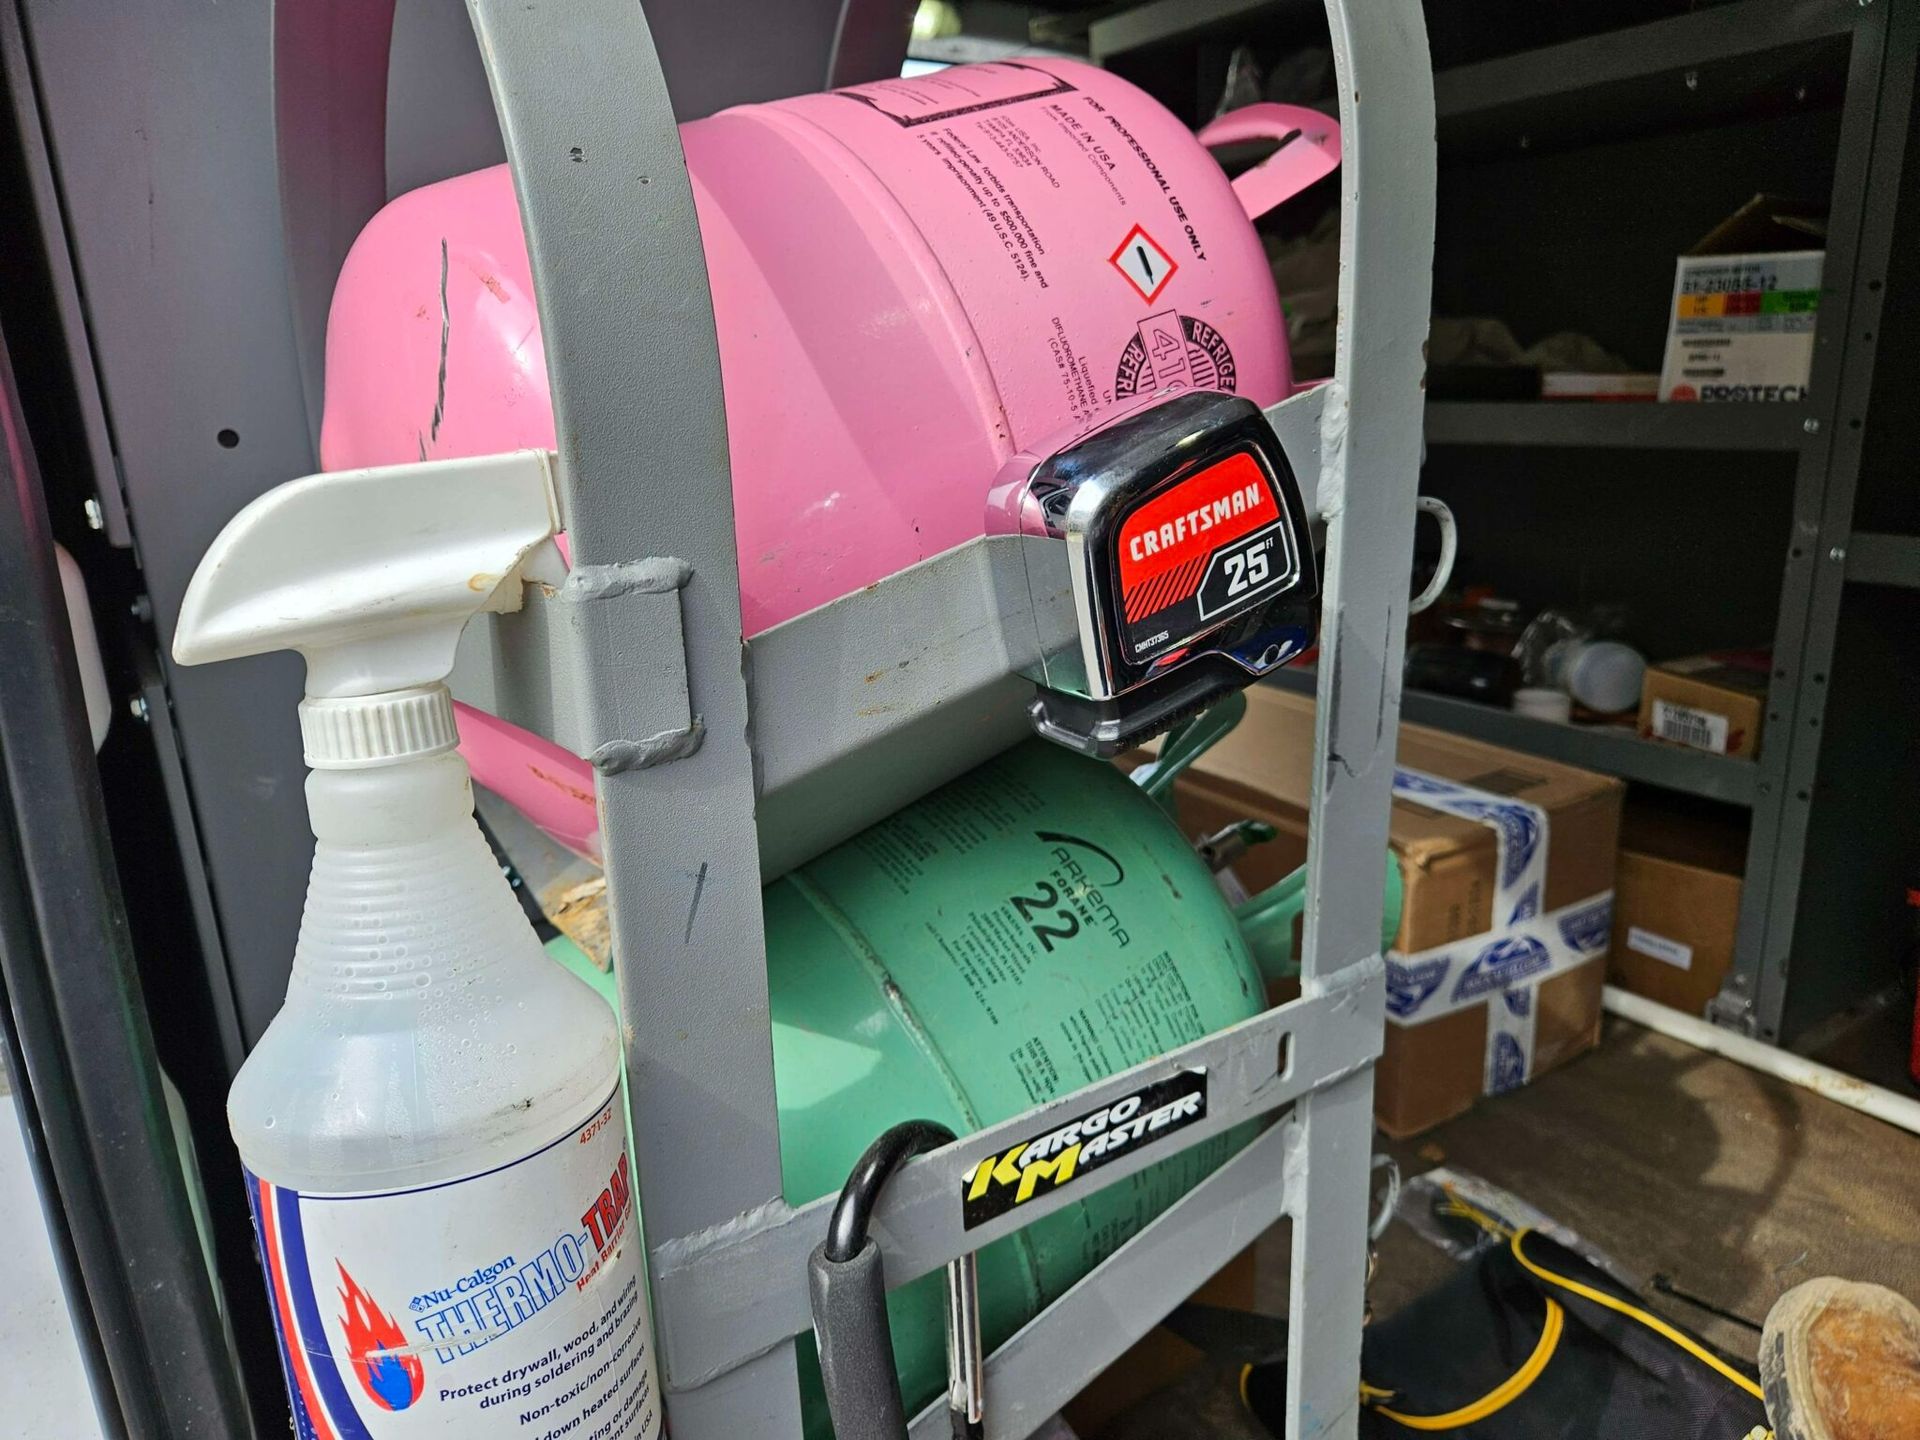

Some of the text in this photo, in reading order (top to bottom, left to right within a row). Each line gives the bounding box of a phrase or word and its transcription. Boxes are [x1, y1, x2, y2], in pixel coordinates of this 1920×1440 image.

[1050, 104, 1116, 171] MADE IN USA
[982, 166, 1006, 194] forbids
[1003, 194, 1045, 256] transportation
[1041, 166, 1060, 188] ROAD
[1083, 96, 1207, 262] FOR PROFESSIONAL USE ONLY
[1087, 153, 1127, 206] Components
[942, 158, 986, 208] imprisonment
[982, 208, 997, 223] (49
[993, 223, 1014, 252] U.S.C.
[1010, 253, 1030, 282] 5124).
[982, 186, 993, 199] up
[991, 198, 1000, 208] to
[1000, 210, 1028, 250] $500,000
[1024, 250, 1038, 269] fine
[1035, 269, 1049, 289] and
[1048, 337, 1065, 368] (CAS#
[1061, 373, 1079, 412] 75-10-5
[1051, 317, 1088, 410] DIFLUOROMETHANE
[1078, 356, 1098, 406] Liquefied
[1129, 482, 1260, 562] CRAFTSMAN
[1224, 536, 1274, 597] 25 FT
[1010, 881, 1079, 952] 22
[1050, 870, 1094, 926] FORANE
[580, 1107, 611, 1144] 4371-32
[968, 1096, 1142, 1201] KARGO
[1015, 1091, 1202, 1203] MASTER
[601, 1218, 625, 1262] Barrier
[423, 1256, 516, 1309] Nu-Calgon
[440, 1274, 636, 1402] Protect drywall, wood, and wiring
[480, 1290, 638, 1409] during soldering and brazing
[519, 1316, 641, 1425] Non-toxic/non-corrosive
[544, 1342, 645, 1440] down heated surfaces
[613, 1408, 622, 1423] or
[624, 1369, 647, 1411] damage
[625, 1384, 649, 1428] surfaces
[642, 1409, 653, 1433] USA
